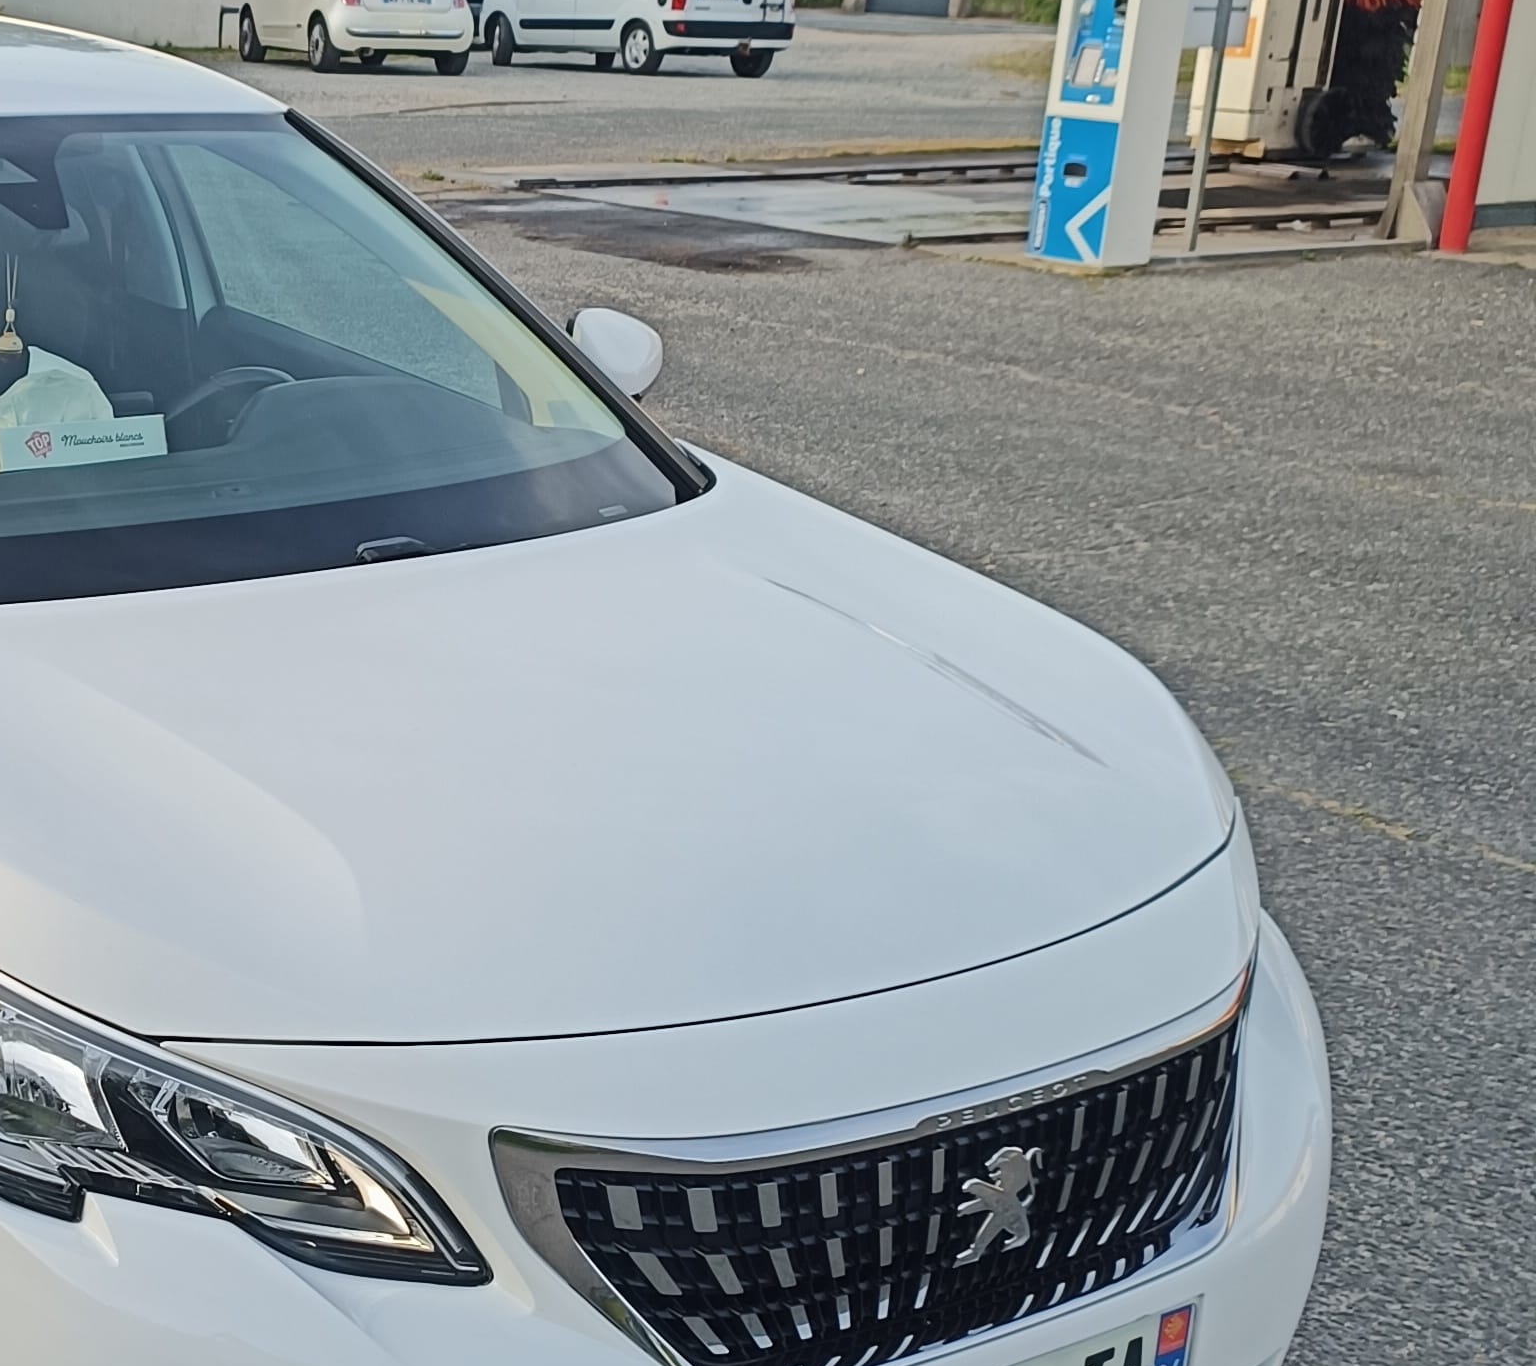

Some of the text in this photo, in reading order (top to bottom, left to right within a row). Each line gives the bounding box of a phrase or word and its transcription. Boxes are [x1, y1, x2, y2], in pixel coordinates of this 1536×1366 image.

[28, 433, 51, 452] TOP
[61, 434, 114, 447] Mouchoirs
[935, 1075, 1088, 1132] PEUGEOT
